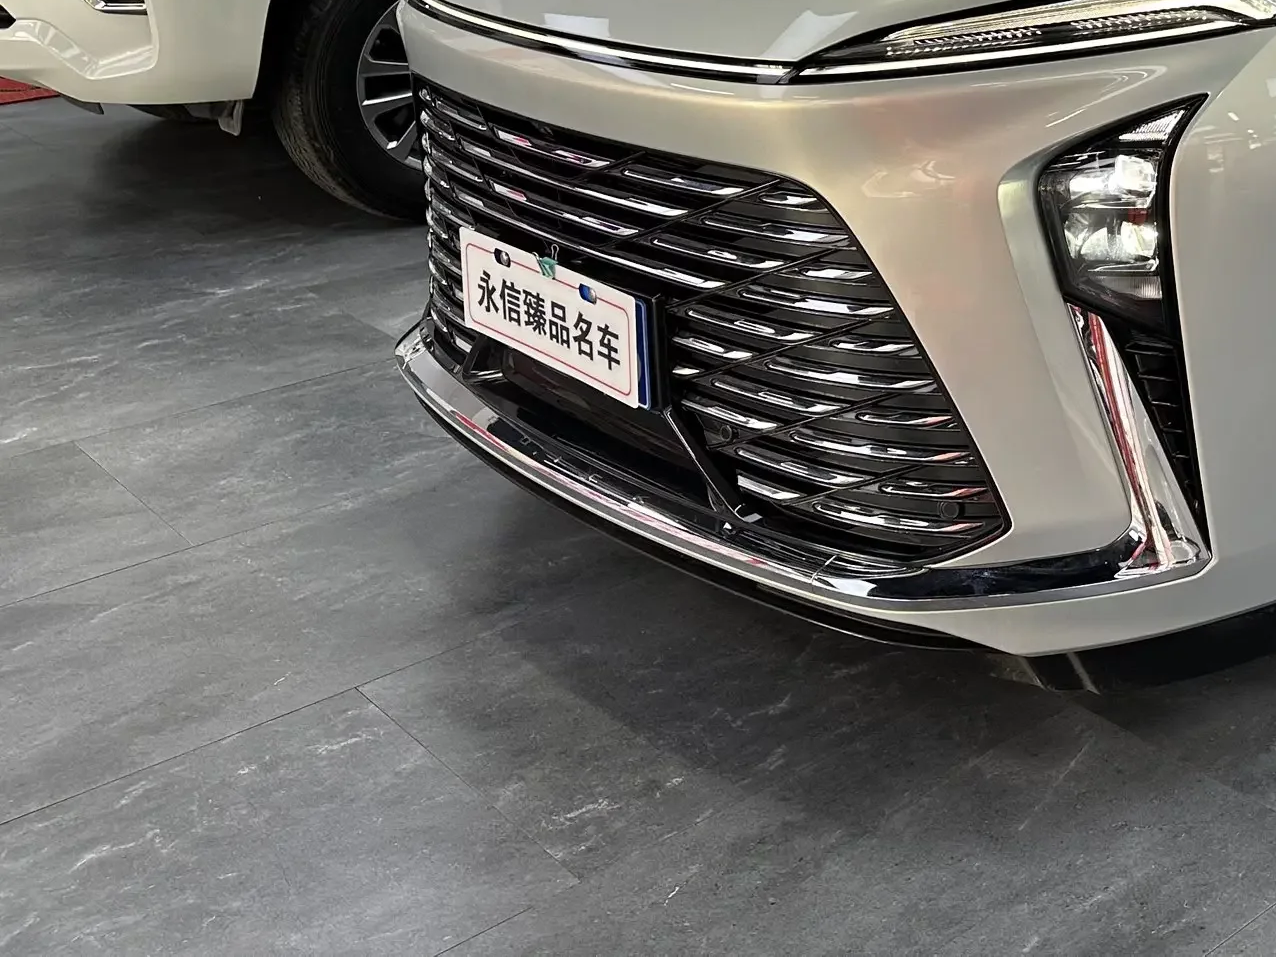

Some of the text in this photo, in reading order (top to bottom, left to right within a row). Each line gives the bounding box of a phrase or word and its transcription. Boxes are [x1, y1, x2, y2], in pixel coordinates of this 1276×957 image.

[476, 269, 622, 371] 永信臻品名车
